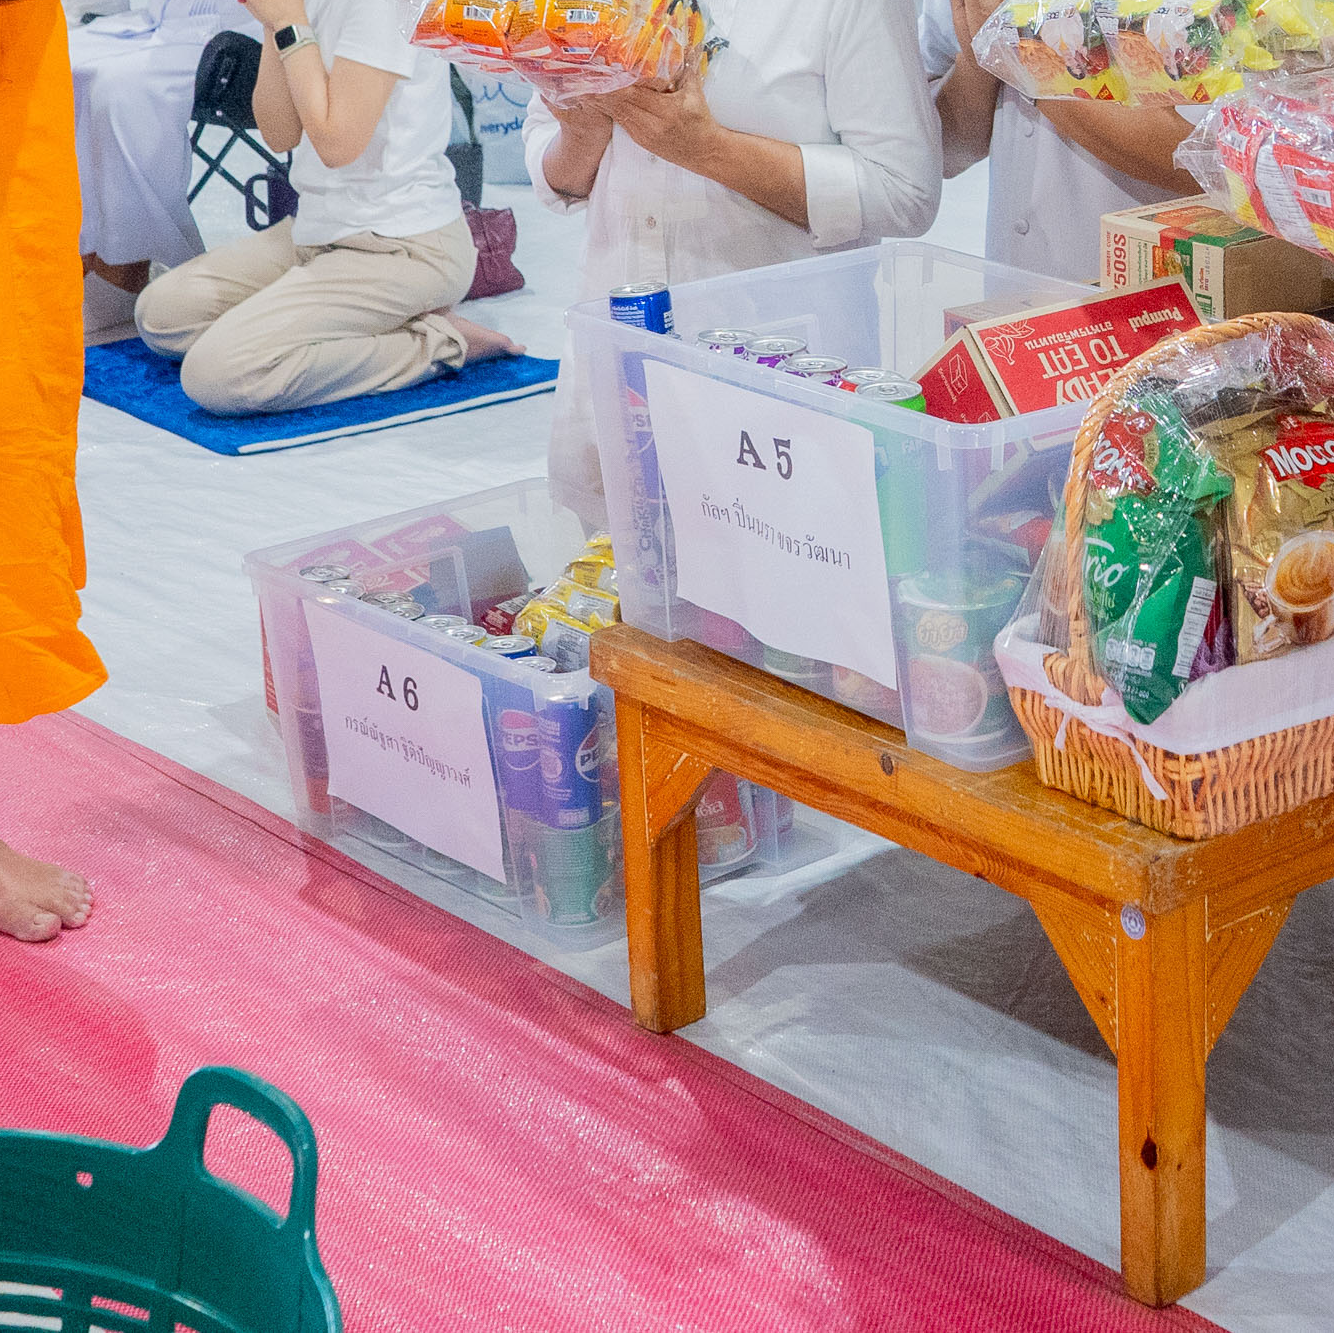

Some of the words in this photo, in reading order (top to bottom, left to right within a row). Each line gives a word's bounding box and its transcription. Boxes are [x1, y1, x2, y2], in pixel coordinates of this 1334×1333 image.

[1128, 306, 1184, 333] Pumpui
[1024, 321, 1114, 351] อาหารพร้อมทาน
[1089, 335, 1130, 365] TO
[1037, 343, 1091, 379] EAT
